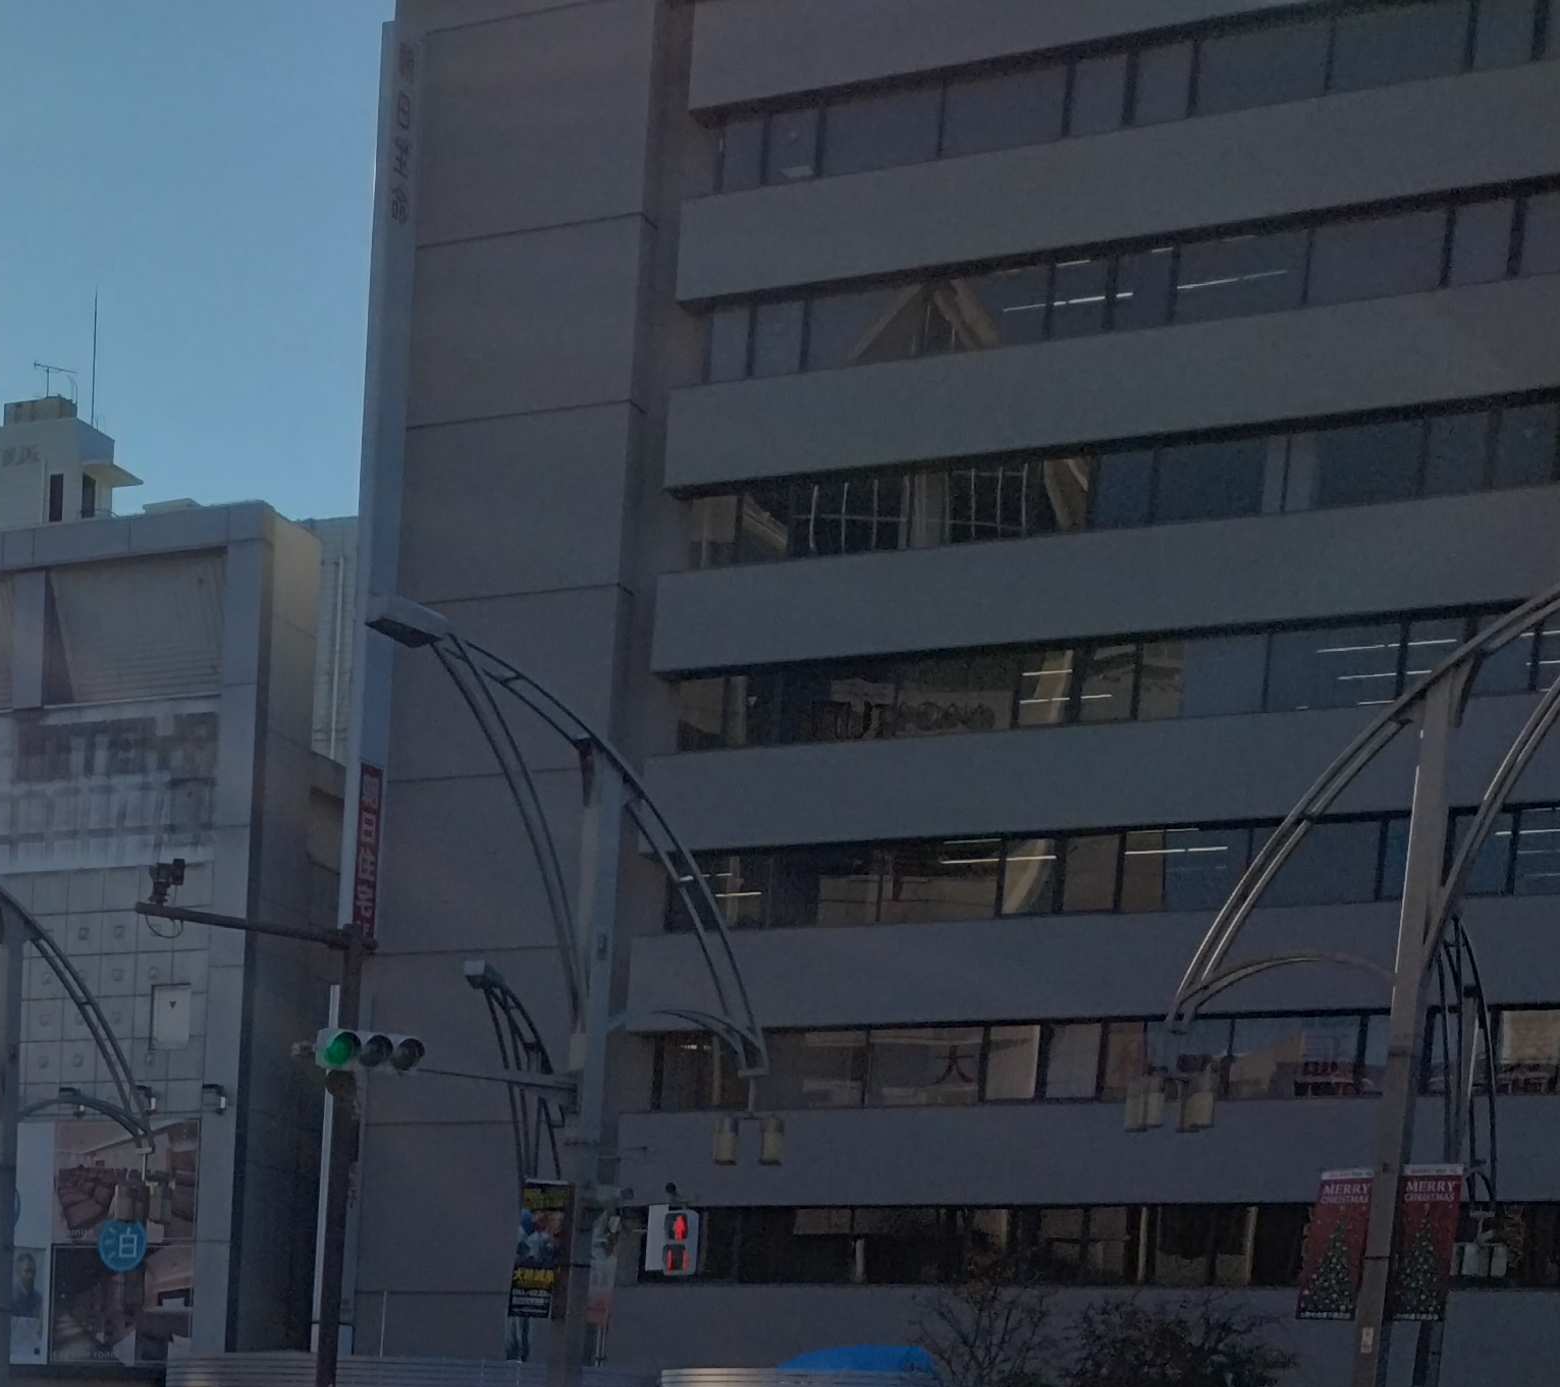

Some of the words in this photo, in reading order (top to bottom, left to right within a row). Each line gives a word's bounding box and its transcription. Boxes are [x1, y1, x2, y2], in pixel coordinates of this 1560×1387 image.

[1323, 1182, 1371, 1195] MERRY
[1405, 1180, 1455, 1192] MERRY
[1320, 1195, 1369, 1205] CHRISTMAS
[1404, 1192, 1455, 1203] CHRISTMAS
[104, 1226, 138, 1259] 泊
